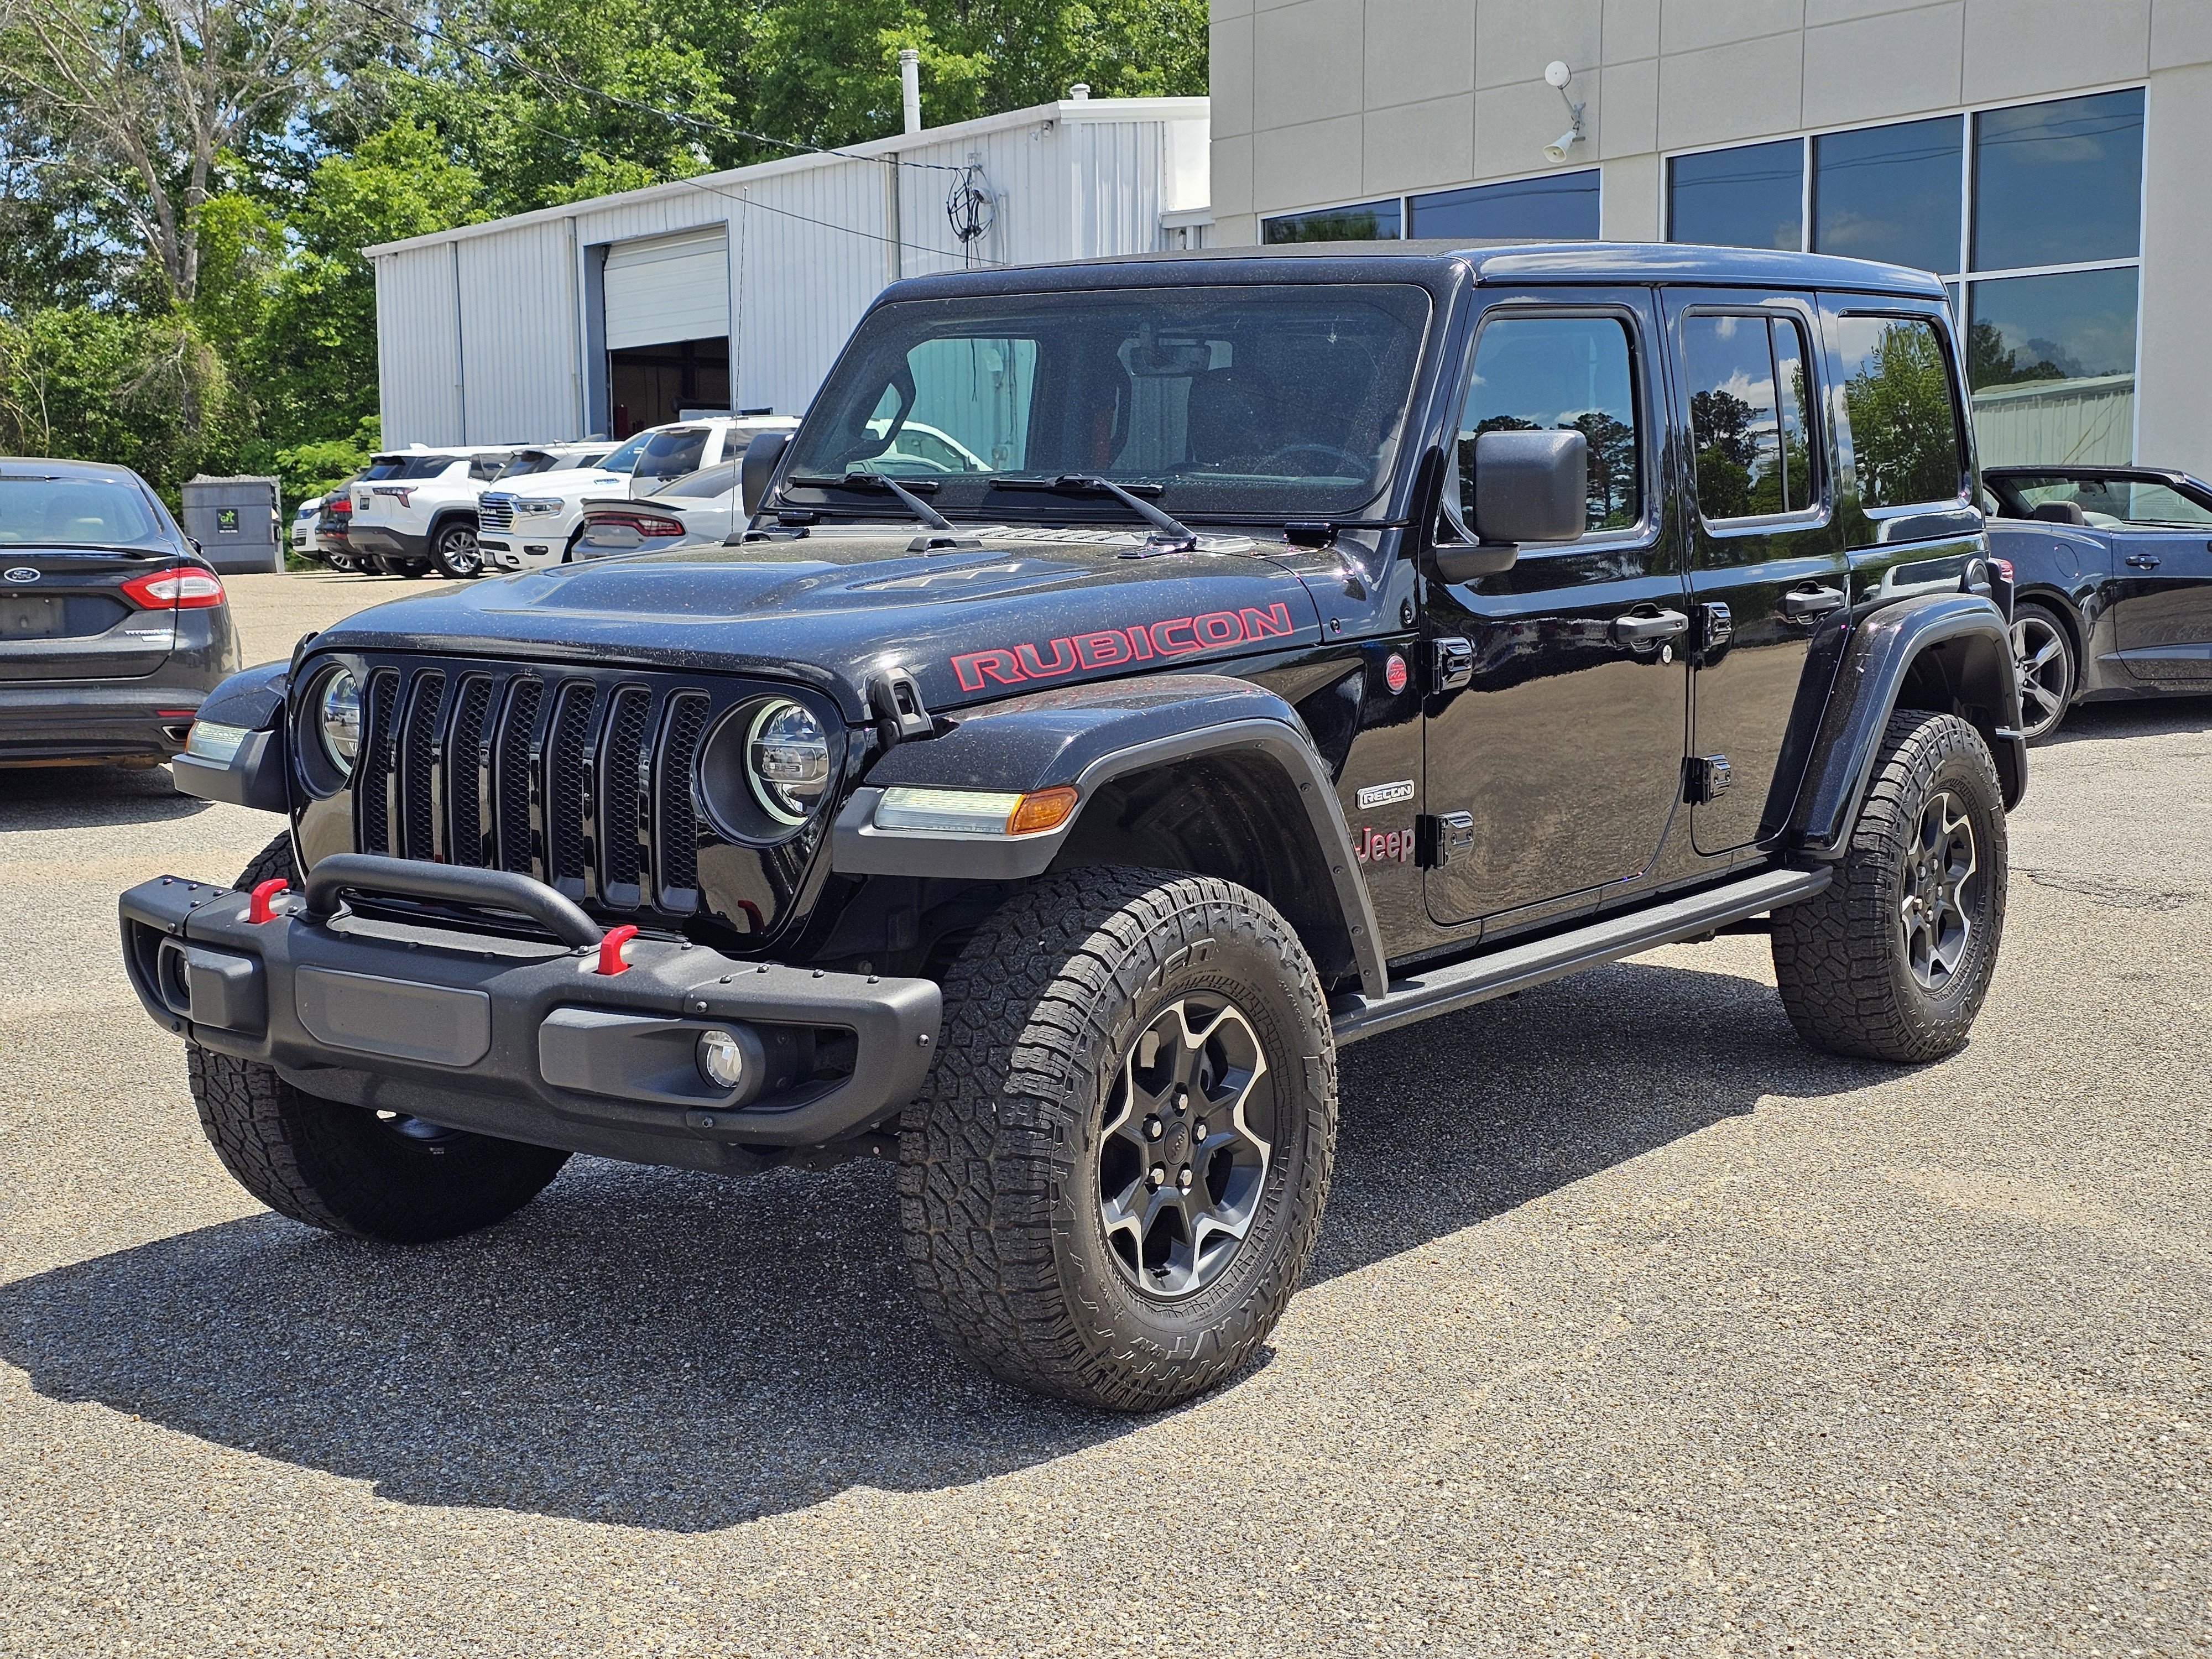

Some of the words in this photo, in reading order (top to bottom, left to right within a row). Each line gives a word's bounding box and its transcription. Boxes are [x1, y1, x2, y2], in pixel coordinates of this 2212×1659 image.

[950, 603, 1293, 692] RUBICON
[1363, 785, 1411, 804] RECON
[1355, 827, 1416, 864] Jeep
